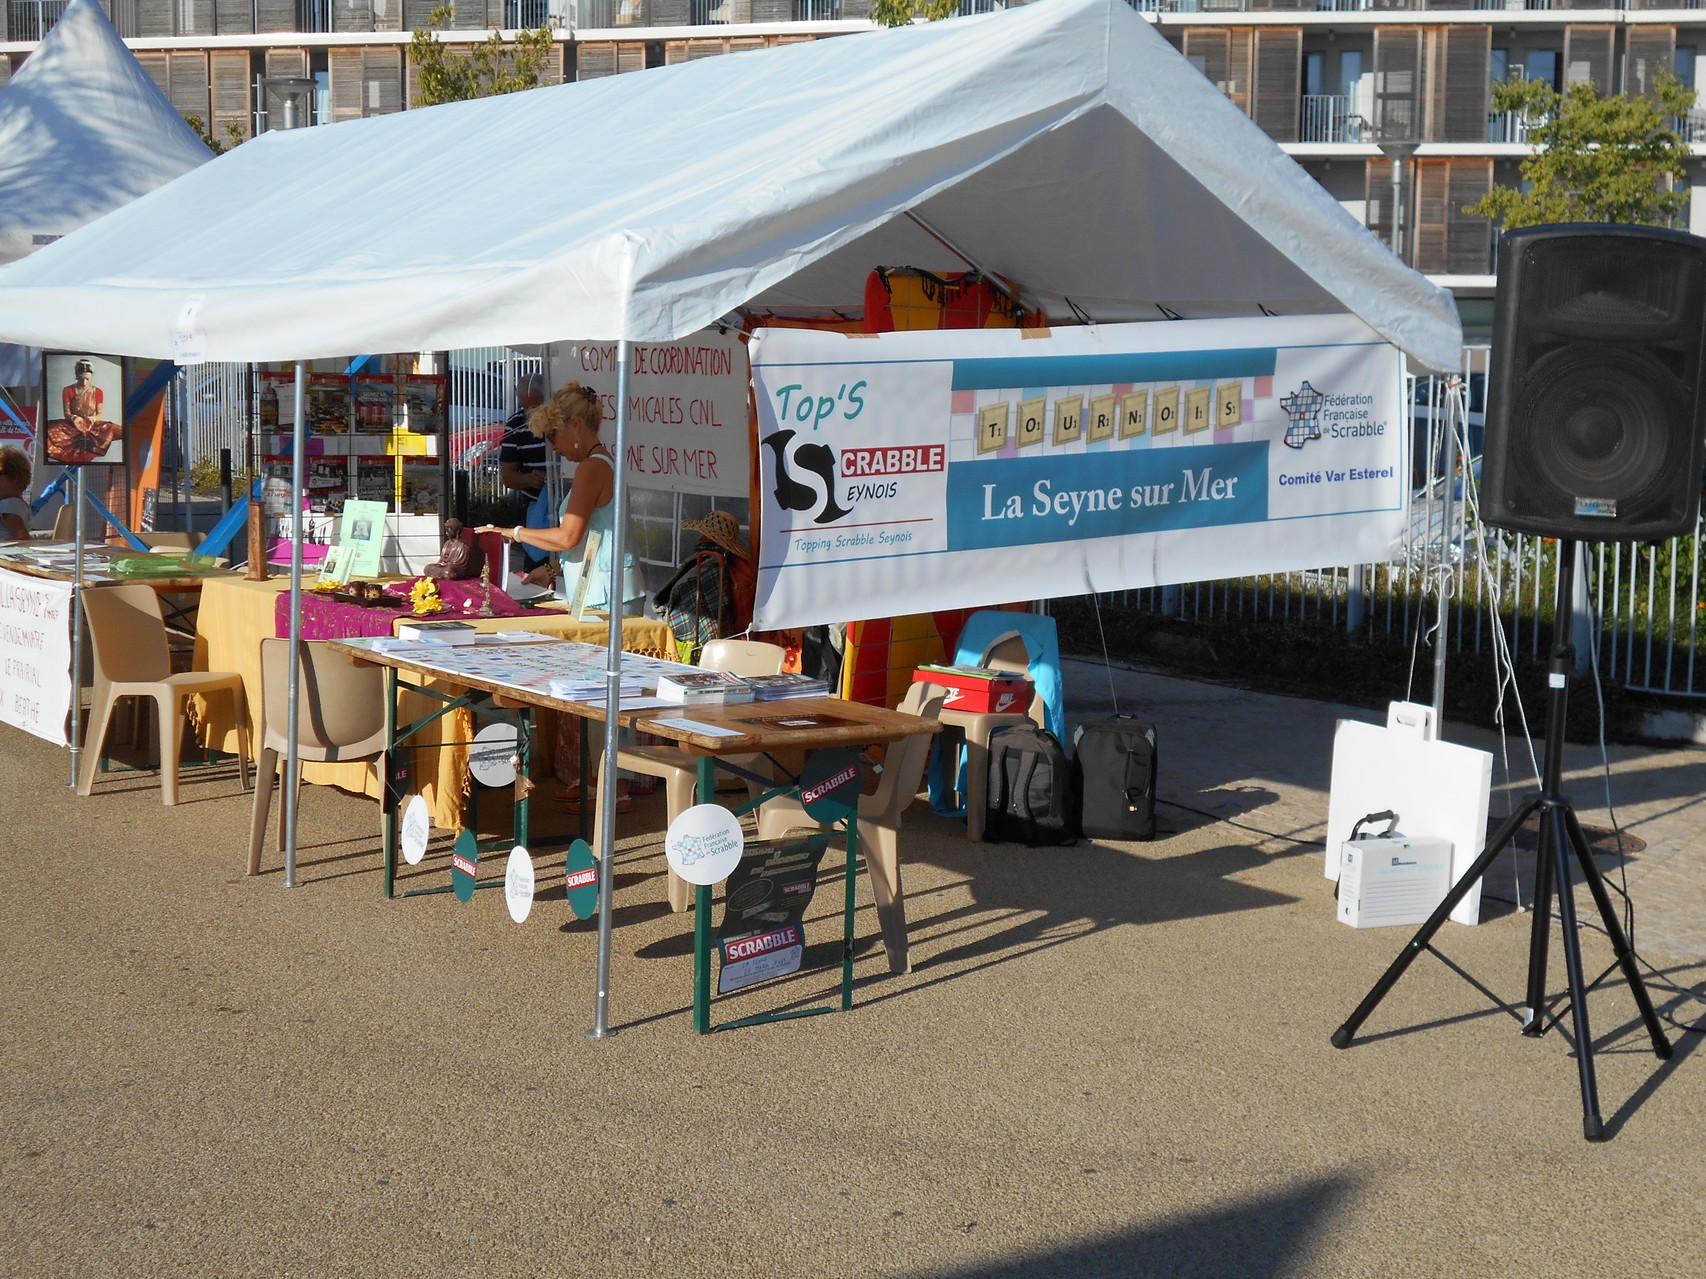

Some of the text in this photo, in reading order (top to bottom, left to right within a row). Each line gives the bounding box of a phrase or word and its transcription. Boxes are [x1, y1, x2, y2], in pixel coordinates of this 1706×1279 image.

[580, 346, 618, 372] COMI
[634, 346, 648, 374] DE
[600, 395, 722, 427] ES MICALES CNL
[776, 380, 867, 431] Top'S
[1324, 393, 1373, 407] Fédération
[1323, 407, 1368, 422] Française
[652, 446, 680, 475] SUR
[683, 449, 718, 480] MER
[842, 448, 943, 476] CRABBLE
[1278, 466, 1394, 487] Comité Var Esterel
[847, 482, 898, 502] EYNOIS
[981, 467, 1239, 526] La Seyne sur Mer
[794, 530, 913, 554] Topping Scrabble Seynois
[804, 767, 857, 804] SCRABBLE
[702, 829, 730, 842] Fédération
[710, 840, 739, 857] Scrabble
[453, 856, 477, 877] SCRABBLE
[567, 872, 596, 887] SCRABBLE
[784, 882, 812, 893] SCRABBLE
[729, 929, 796, 960] SCRABBLE
